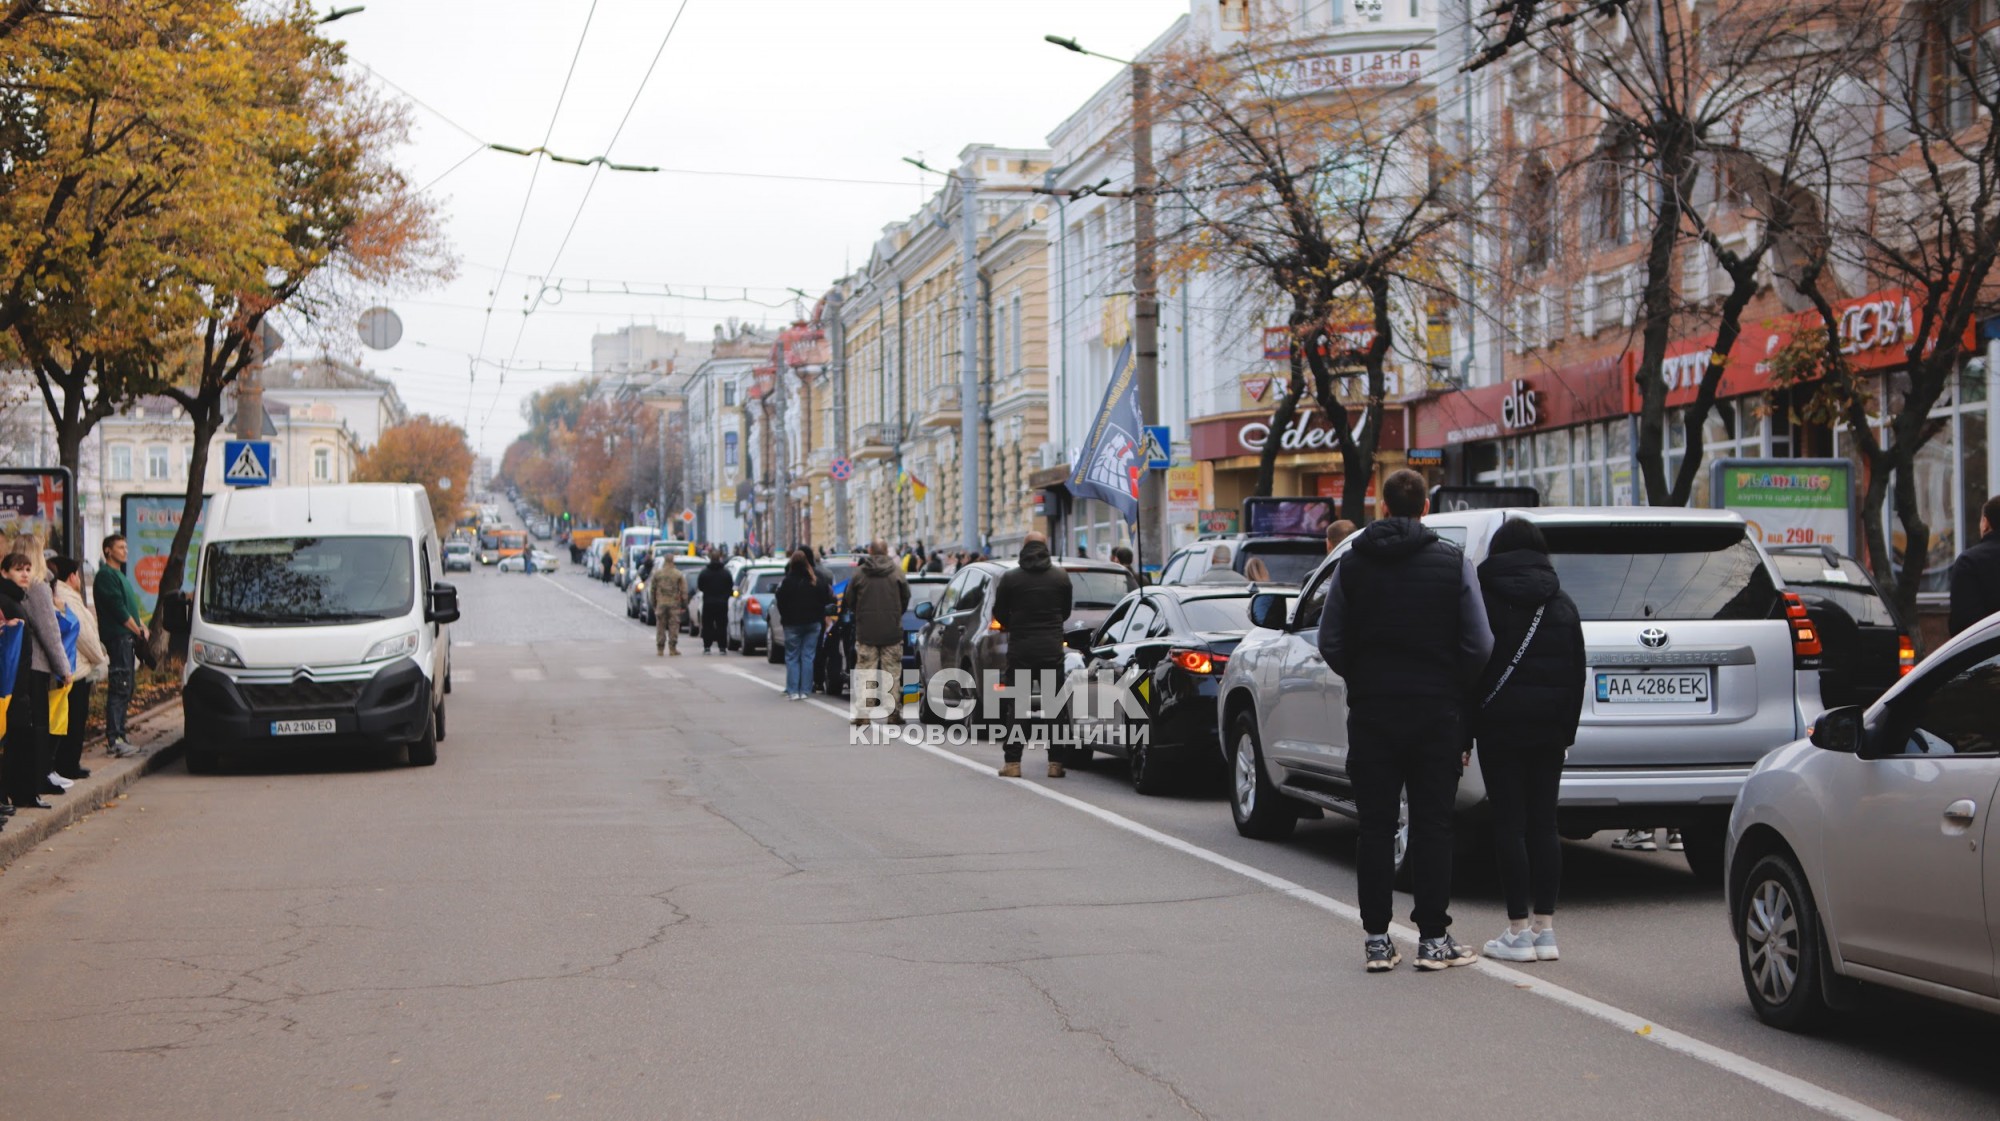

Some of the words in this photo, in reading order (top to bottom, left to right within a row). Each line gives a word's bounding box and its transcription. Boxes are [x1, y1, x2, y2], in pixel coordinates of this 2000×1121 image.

[1298, 53, 1421, 79] ПРОВІДНА
[1502, 378, 1537, 428] elis
[1786, 528, 1814, 544] 290
[1609, 678, 1633, 695] AA
[1636, 678, 1676, 695] 4286
[1679, 677, 1703, 695] EK
[277, 722, 291, 732] AA
[293, 722, 316, 732] 2106
[317, 721, 333, 731] EO
